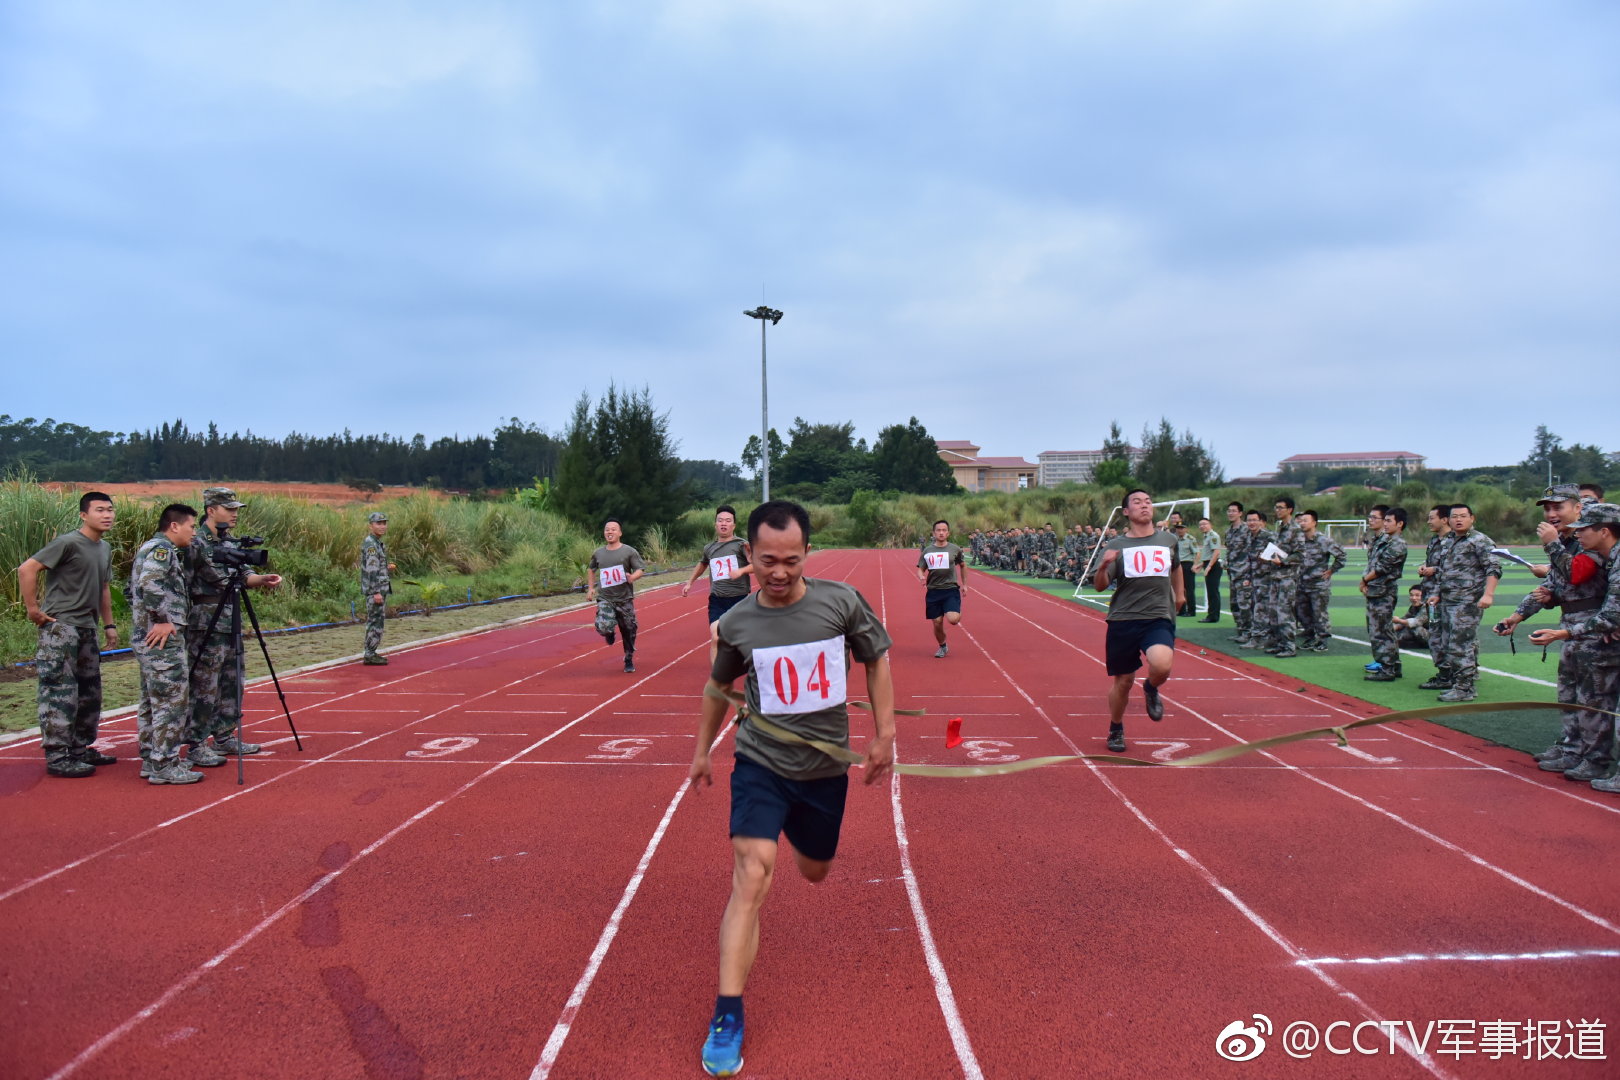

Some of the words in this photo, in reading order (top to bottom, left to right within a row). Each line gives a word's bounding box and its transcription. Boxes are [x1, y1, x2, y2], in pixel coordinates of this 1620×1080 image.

[715, 558, 733, 577] 21
[928, 554, 944, 567] 07
[1133, 550, 1165, 573] 05
[602, 568, 621, 585] 20
[773, 651, 831, 706] 04
